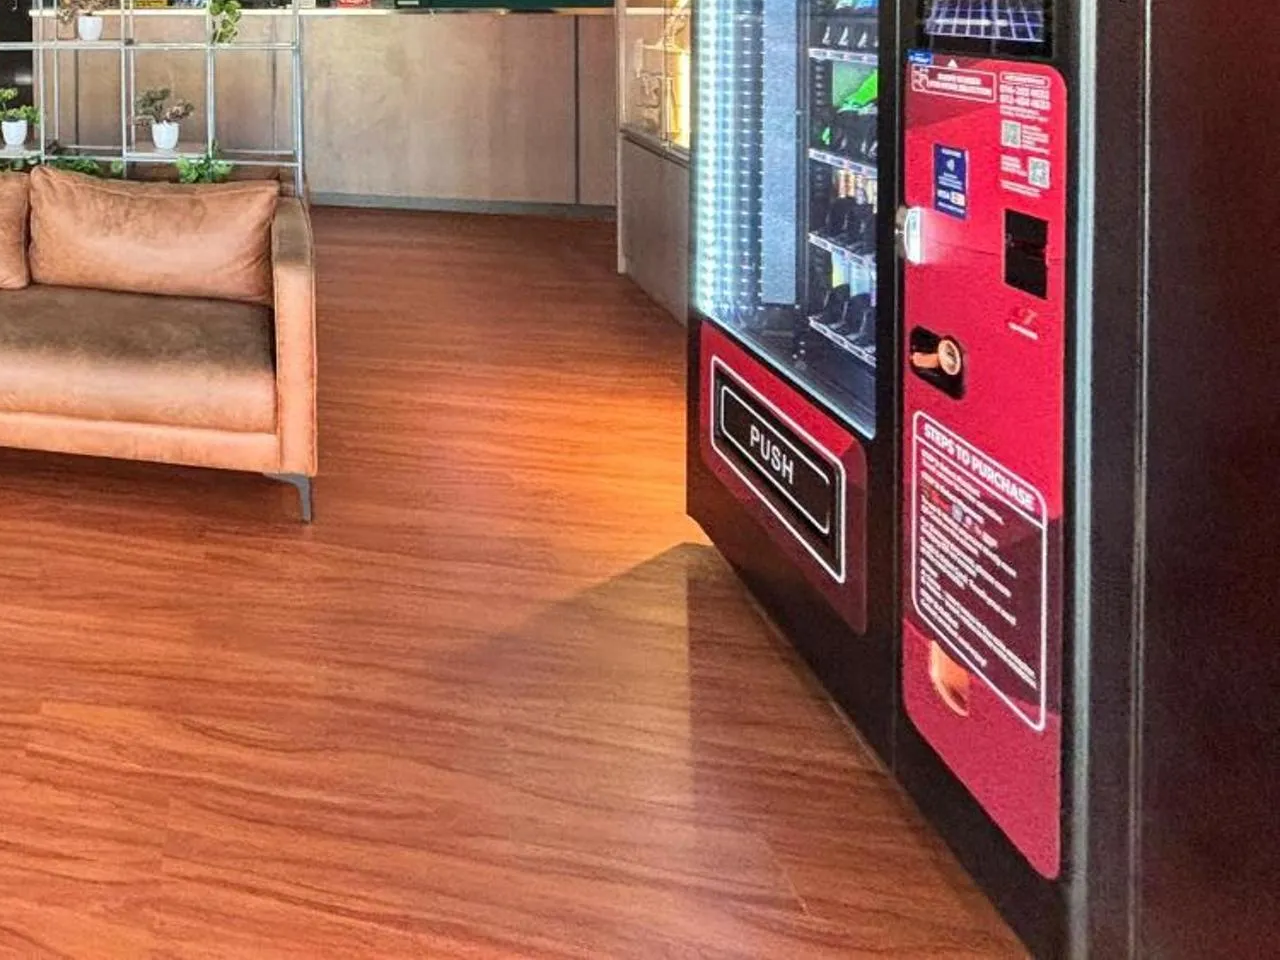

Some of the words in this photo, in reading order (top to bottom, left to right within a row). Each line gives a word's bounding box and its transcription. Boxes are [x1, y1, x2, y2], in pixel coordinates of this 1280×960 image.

[750, 424, 795, 485] PUSH
[924, 422, 956, 456] STEPS
[955, 443, 971, 467] TO
[971, 453, 1037, 513] PURCHASE
